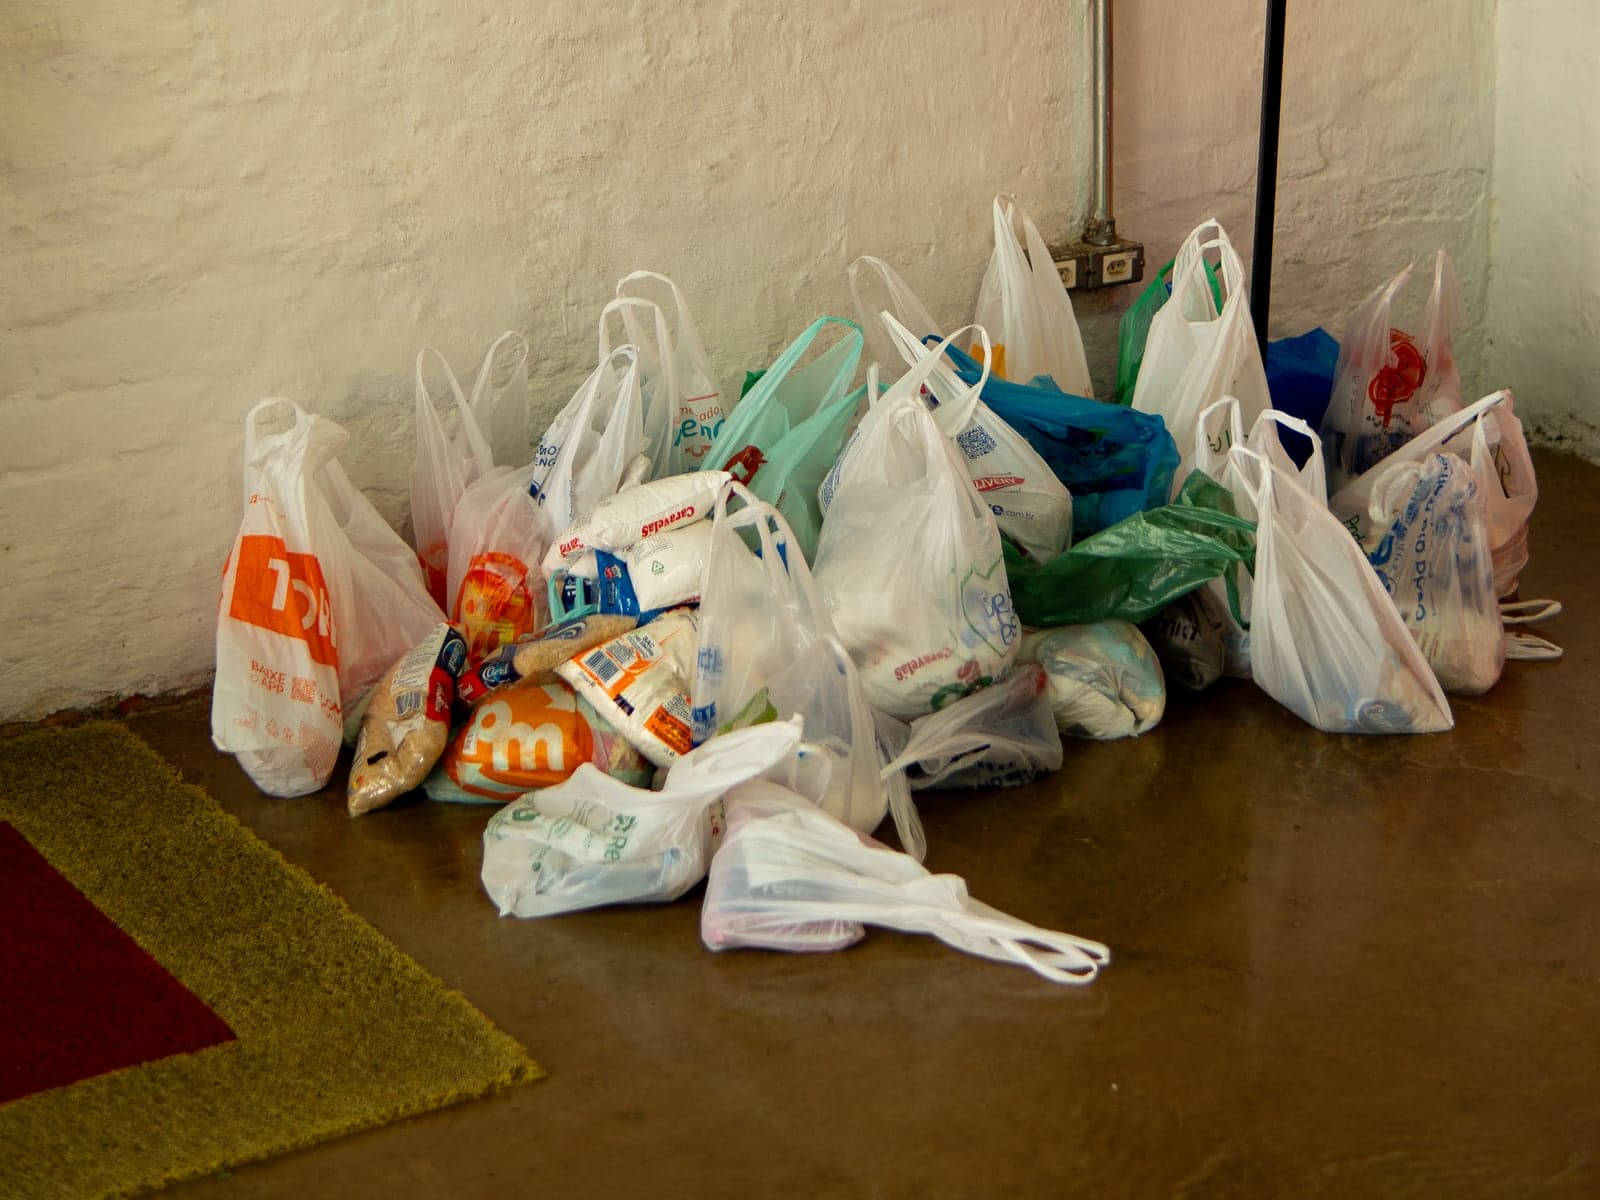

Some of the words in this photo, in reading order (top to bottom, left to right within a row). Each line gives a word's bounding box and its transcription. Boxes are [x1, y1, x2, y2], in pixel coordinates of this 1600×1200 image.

[974, 477, 1016, 490] LIVERY
[251, 660, 287, 685] BAIXE
[261, 678, 285, 694] APP
